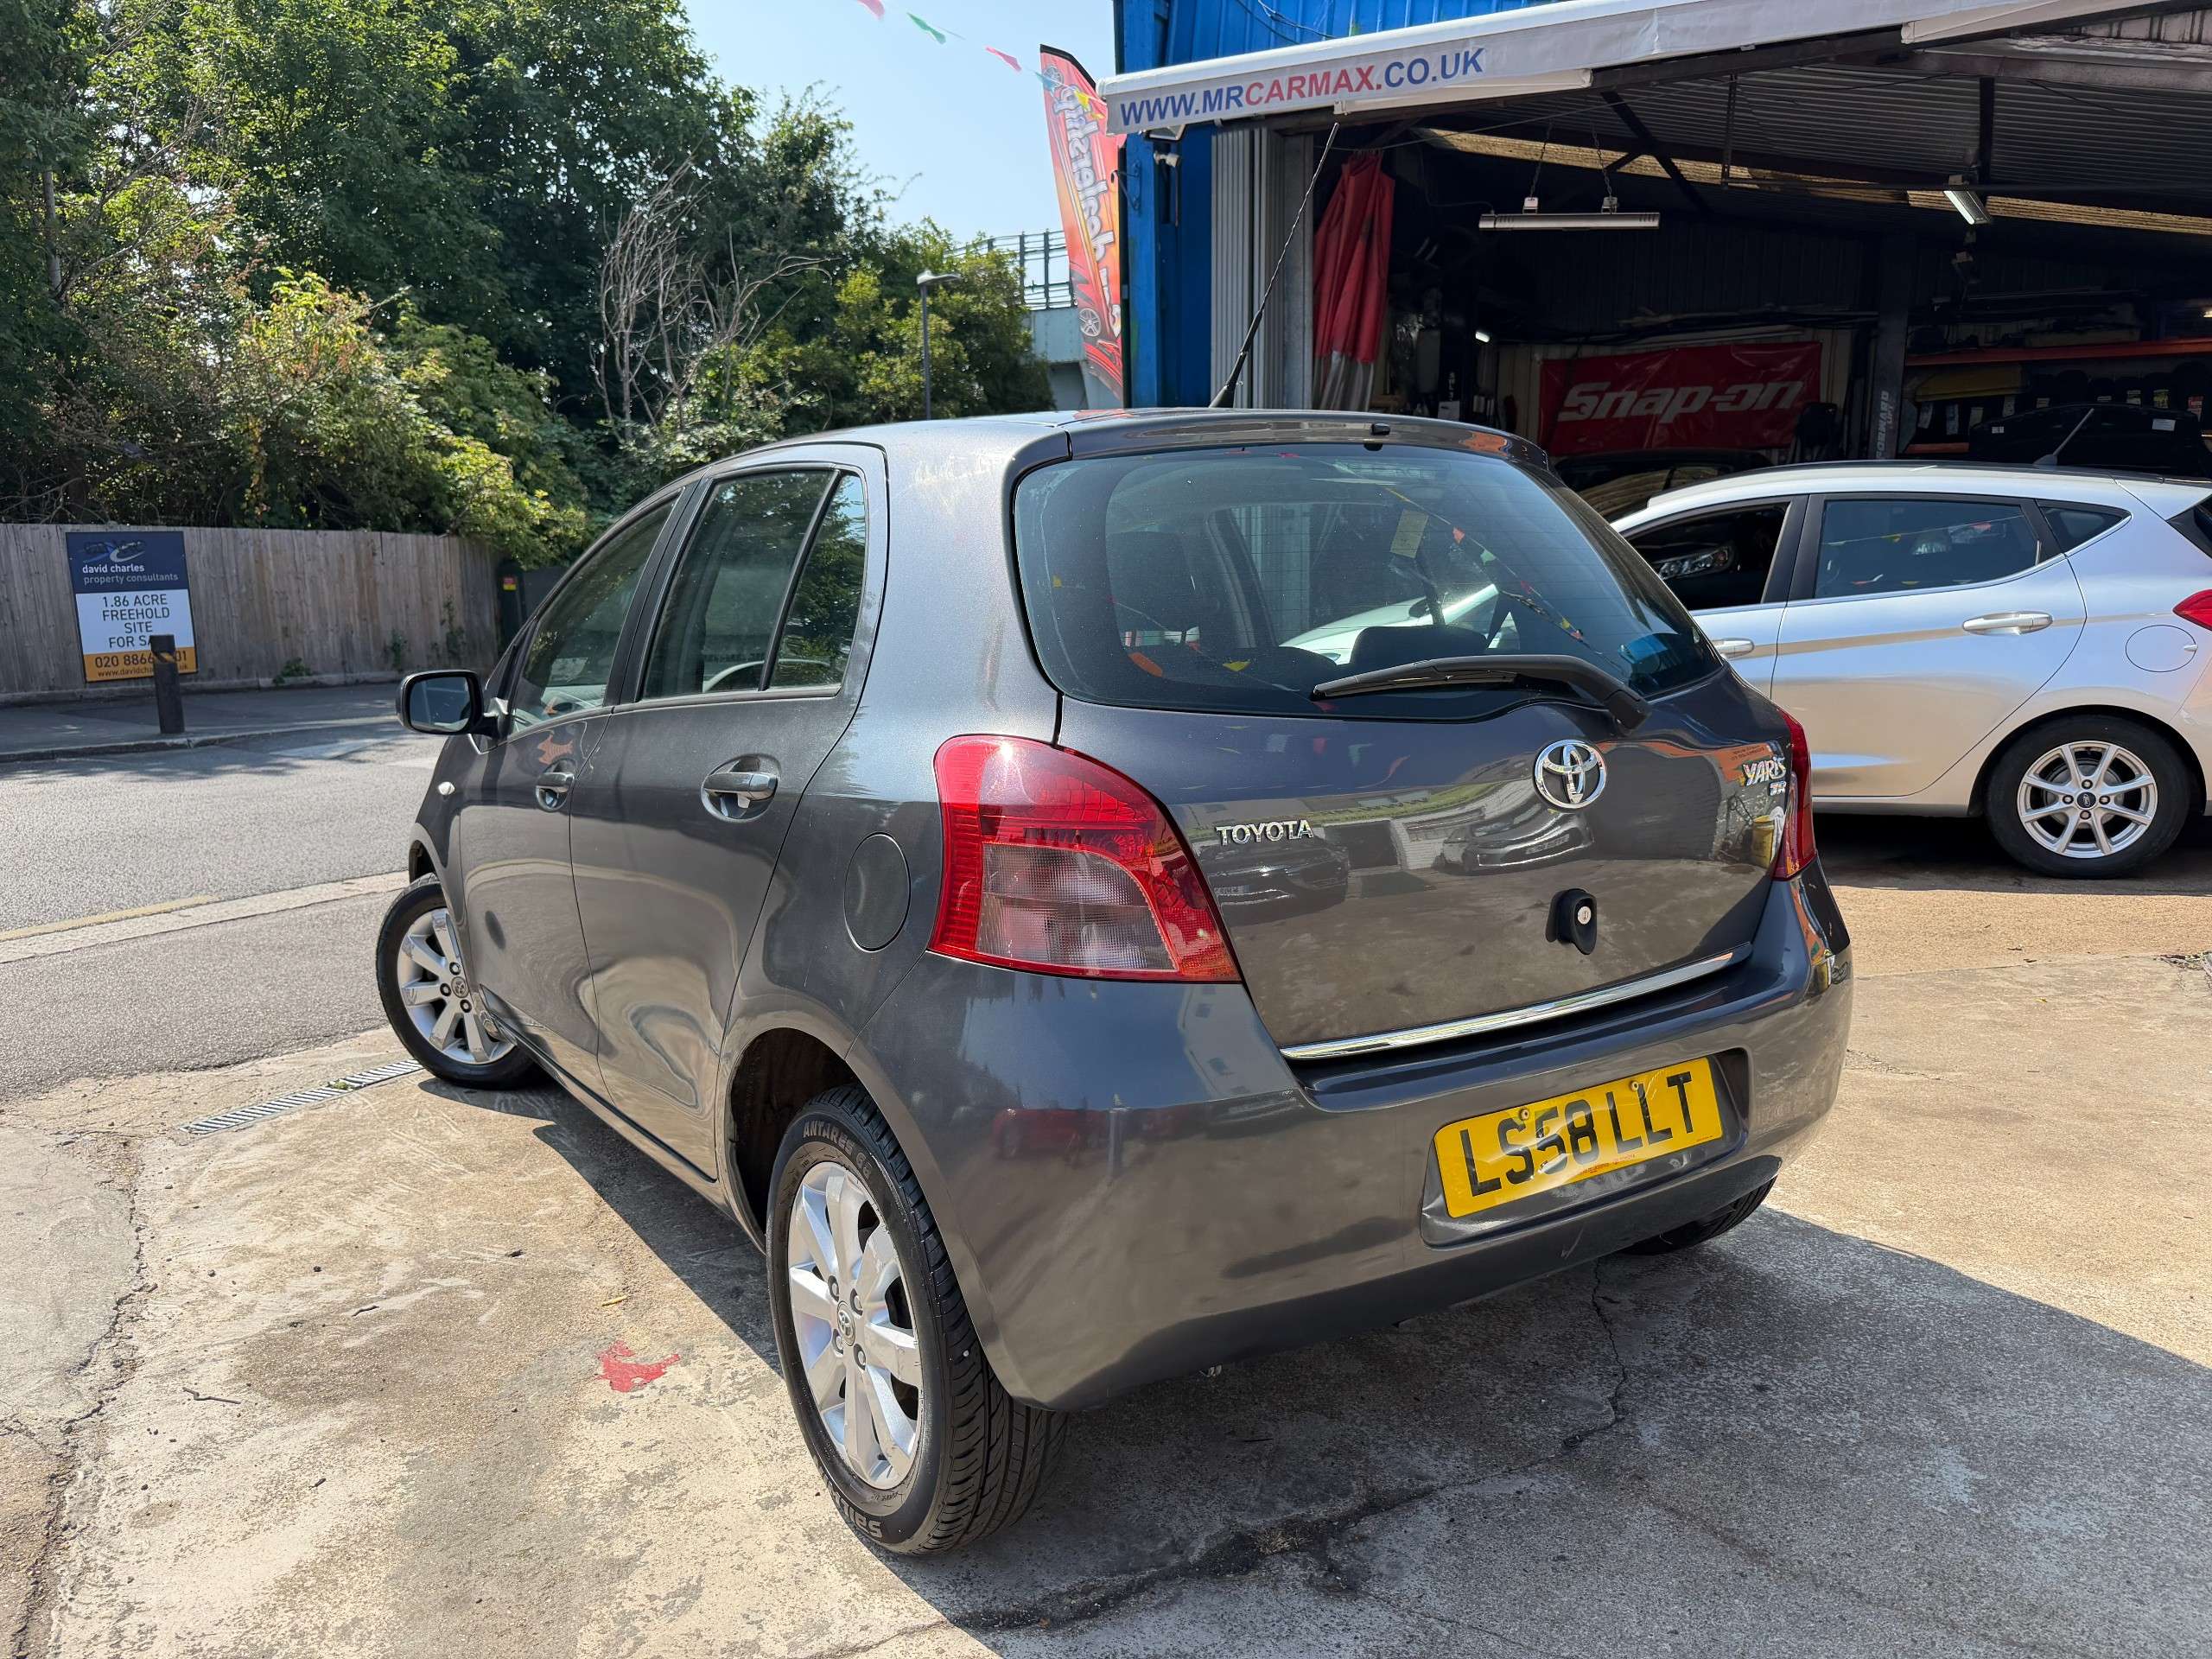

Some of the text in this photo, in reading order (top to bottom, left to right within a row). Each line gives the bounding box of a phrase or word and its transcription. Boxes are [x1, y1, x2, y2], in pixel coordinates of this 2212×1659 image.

[1120, 48, 1485, 126] WWW.MRCARMAX.CO.UK
[1557, 381, 1803, 424] Snap-on
[82, 563, 145, 574] david charles
[84, 573, 179, 585] property consultants
[103, 594, 168, 607] 1.86 ACRE
[102, 607, 170, 621] FREEHOLD
[124, 621, 153, 633] SITE
[109, 636, 135, 648] FOR
[95, 656, 119, 668] 020
[1216, 819, 1313, 846] TOYOTA
[1460, 1071, 1693, 1197] LS58 LLT
